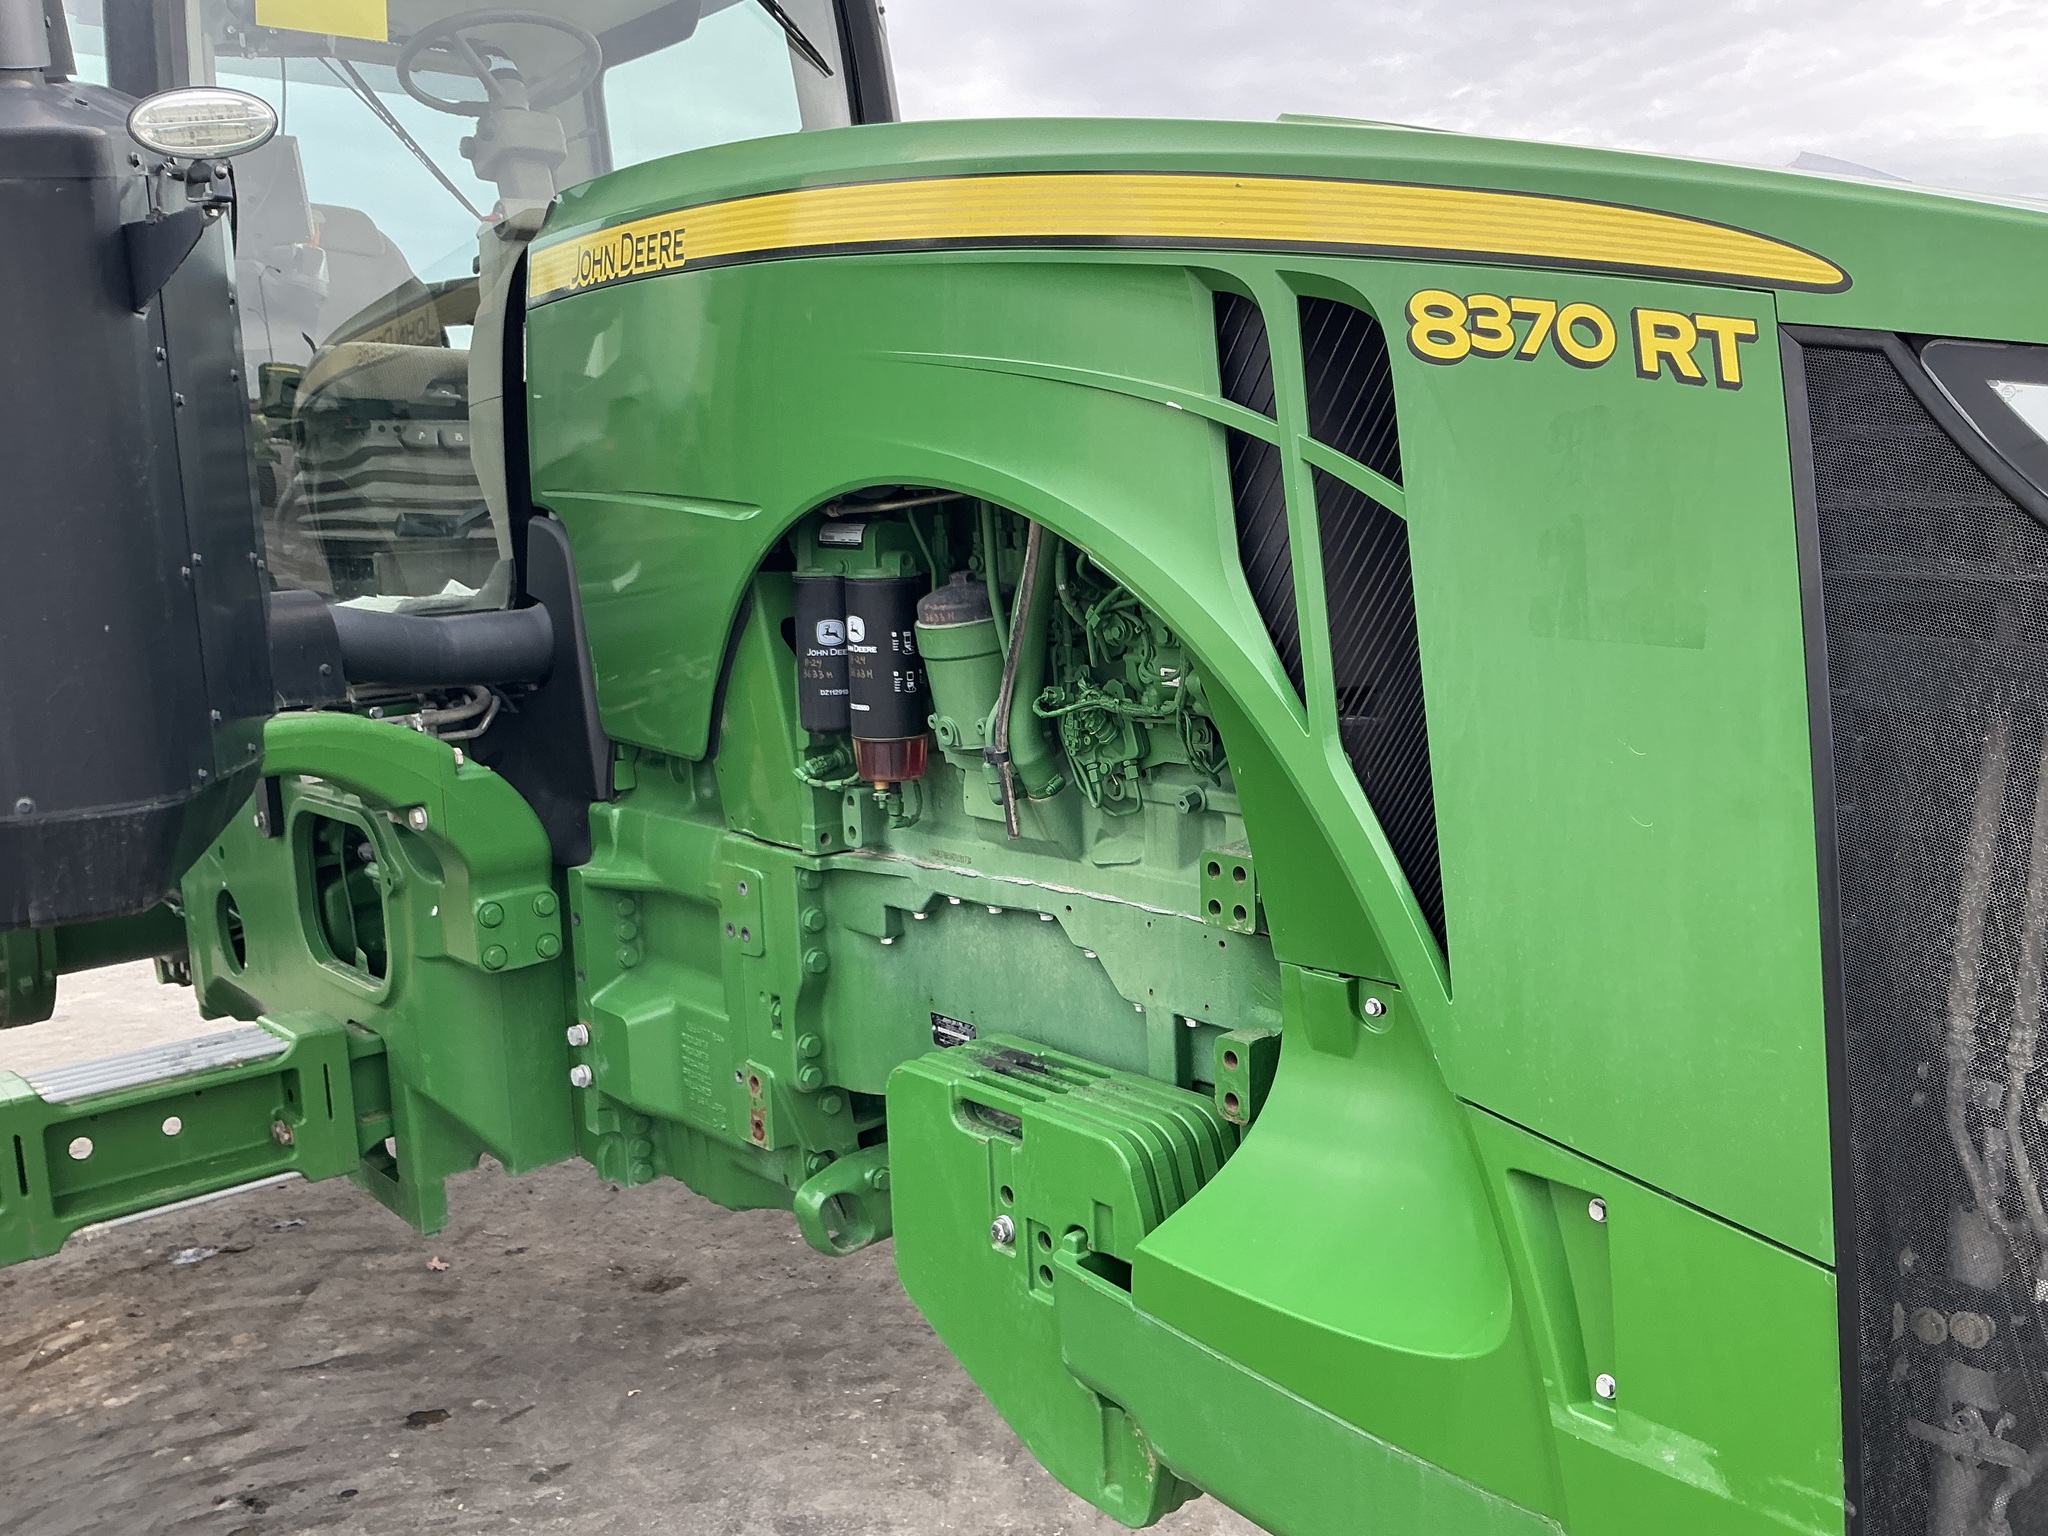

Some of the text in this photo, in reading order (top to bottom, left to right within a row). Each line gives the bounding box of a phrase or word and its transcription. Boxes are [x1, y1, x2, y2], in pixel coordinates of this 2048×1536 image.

[570, 228, 686, 289] JOHN DEERE
[1405, 289, 1759, 391] 8370 RT
[807, 648, 829, 657] JOHN
[853, 644, 877, 653] DEERE
